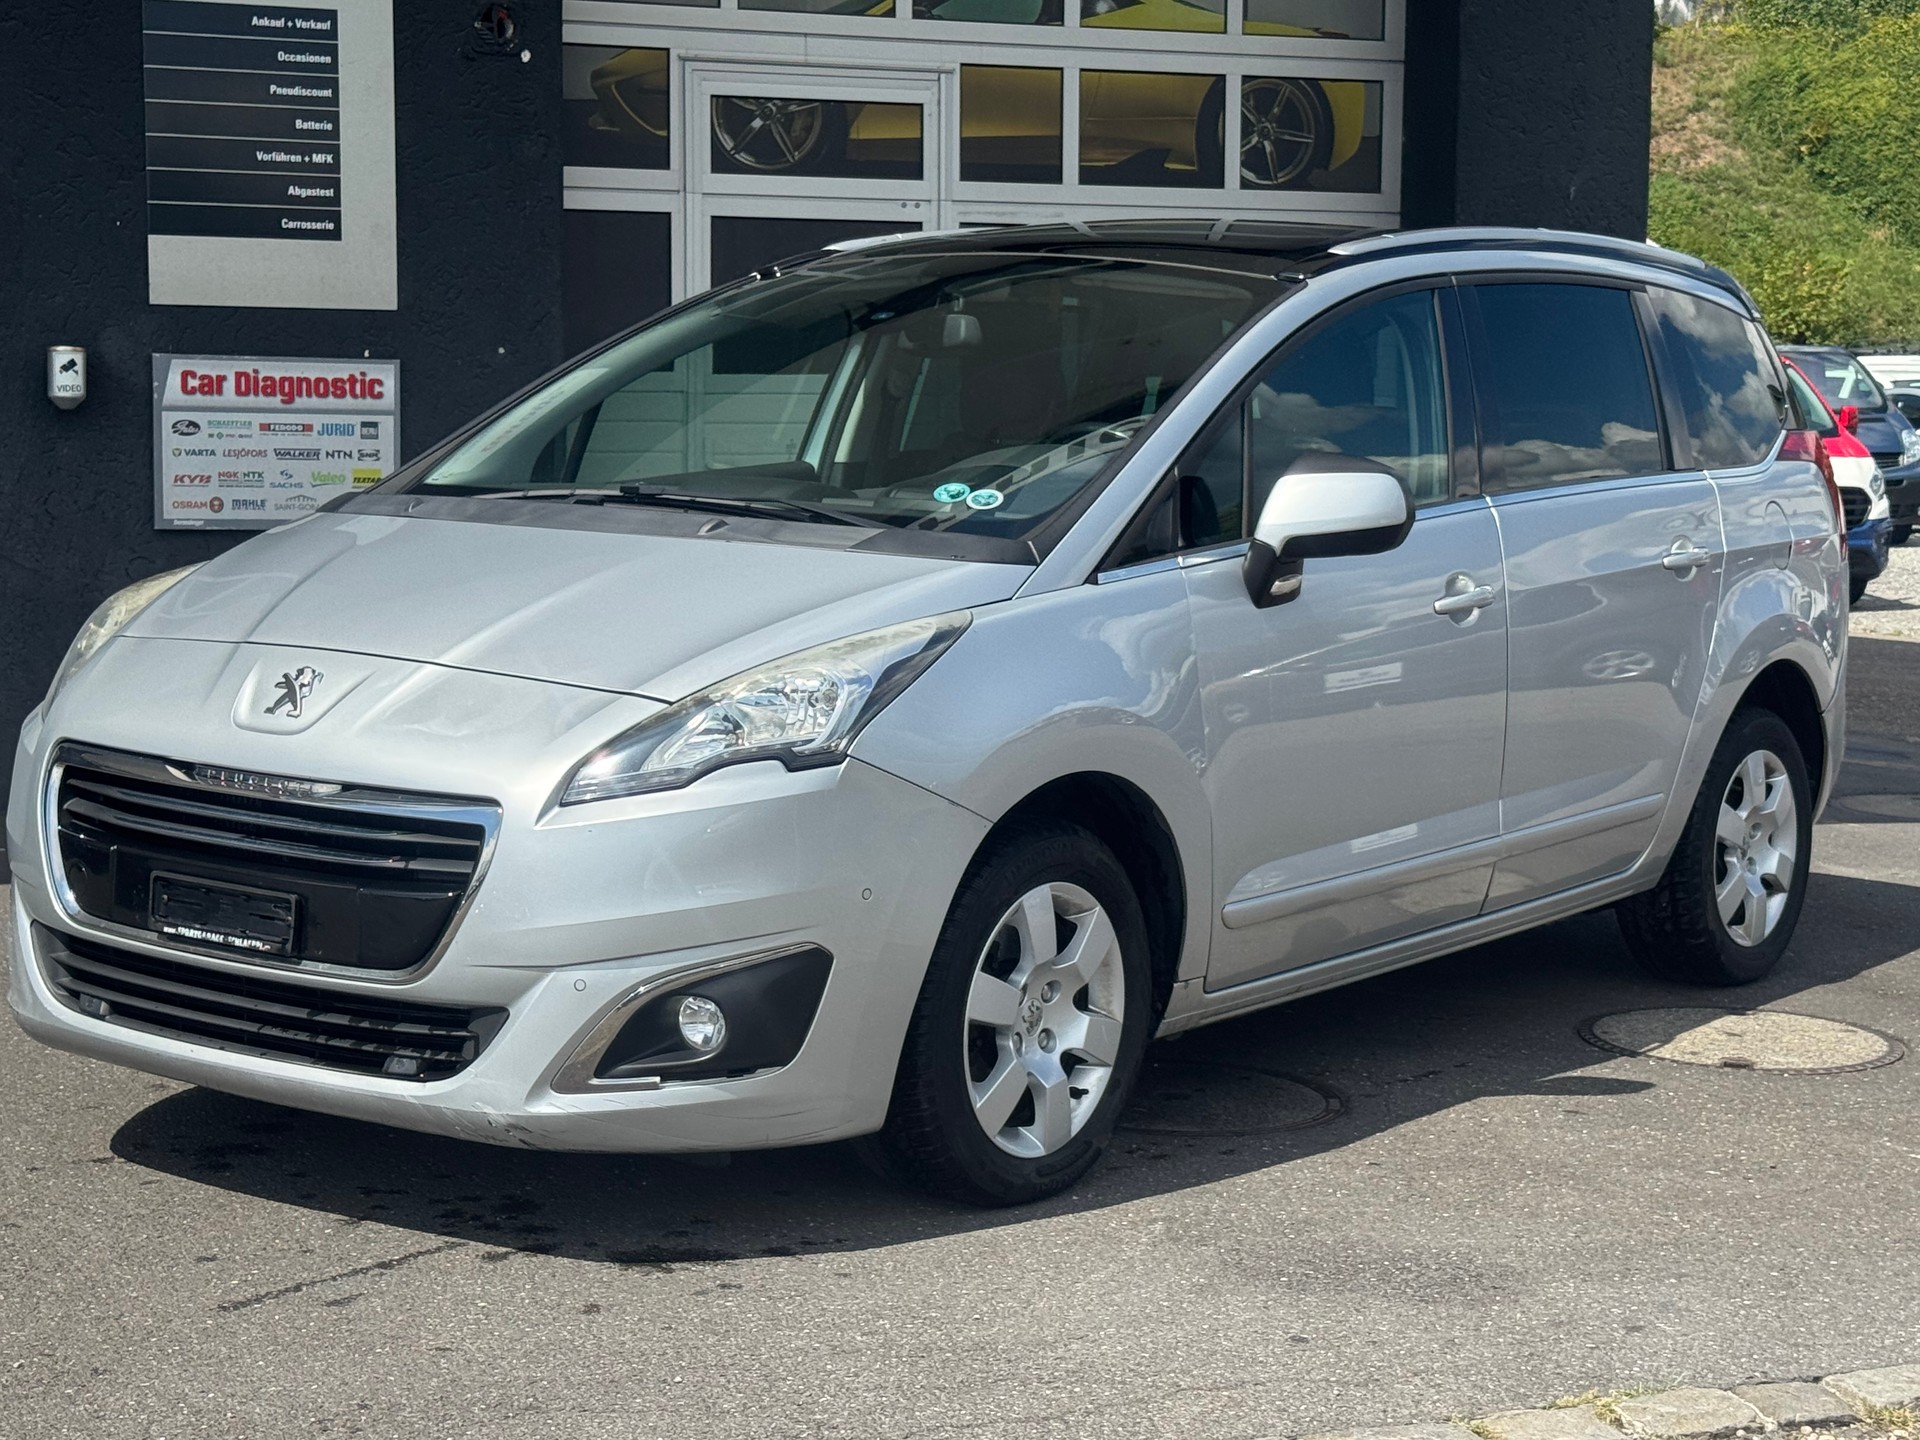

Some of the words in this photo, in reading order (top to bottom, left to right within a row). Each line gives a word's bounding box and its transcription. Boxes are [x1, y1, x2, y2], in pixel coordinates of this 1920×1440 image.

[251, 15, 285, 29] Ankauf
[295, 17, 331, 31] Verkauf
[277, 50, 332, 64] Occasionen
[269, 84, 332, 98] Pneudiscount
[295, 118, 333, 131] Batterie
[256, 150, 302, 163] Vorführen
[312, 153, 334, 164] MFK
[287, 185, 334, 198] Abgastest
[281, 217, 335, 231] Carrosserie
[57, 384, 82, 393] VIDEO
[180, 369, 228, 397] Car
[234, 368, 384, 405] Diagnostic
[317, 422, 355, 437] JURID
[184, 448, 217, 457] VARTA
[274, 448, 321, 459] WALKER
[325, 449, 353, 460] NTN
[218, 471, 239, 479] NGK
[243, 471, 265, 479] NTK
[311, 471, 346, 485] Valeo
[172, 500, 208, 509] OSRAM
[231, 498, 266, 508] MAHLE
